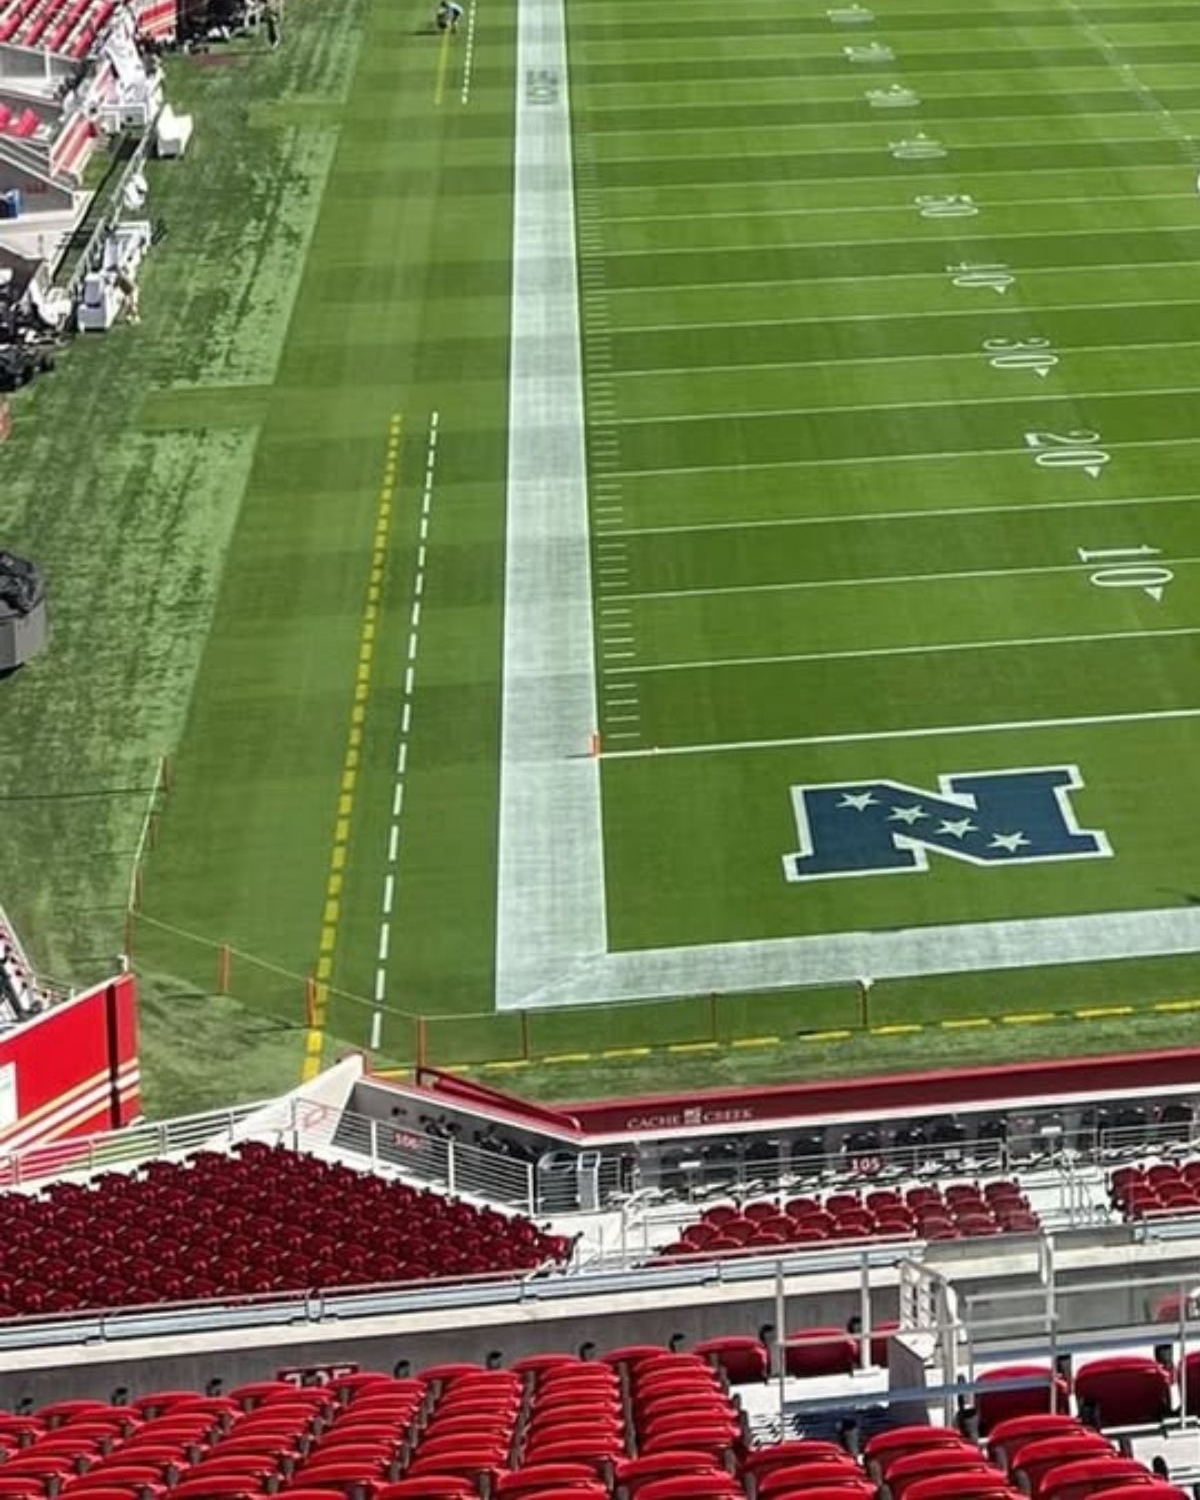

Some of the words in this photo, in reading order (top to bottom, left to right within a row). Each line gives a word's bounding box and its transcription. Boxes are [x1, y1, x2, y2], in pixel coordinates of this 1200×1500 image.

[983, 337, 1059, 367] 30
[1024, 429, 1110, 466] 20
[1077, 545, 1174, 587] 10
[627, 1114, 680, 1130] CACHE
[704, 1108, 753, 1123] CREEK
[851, 1157, 880, 1171] 105
